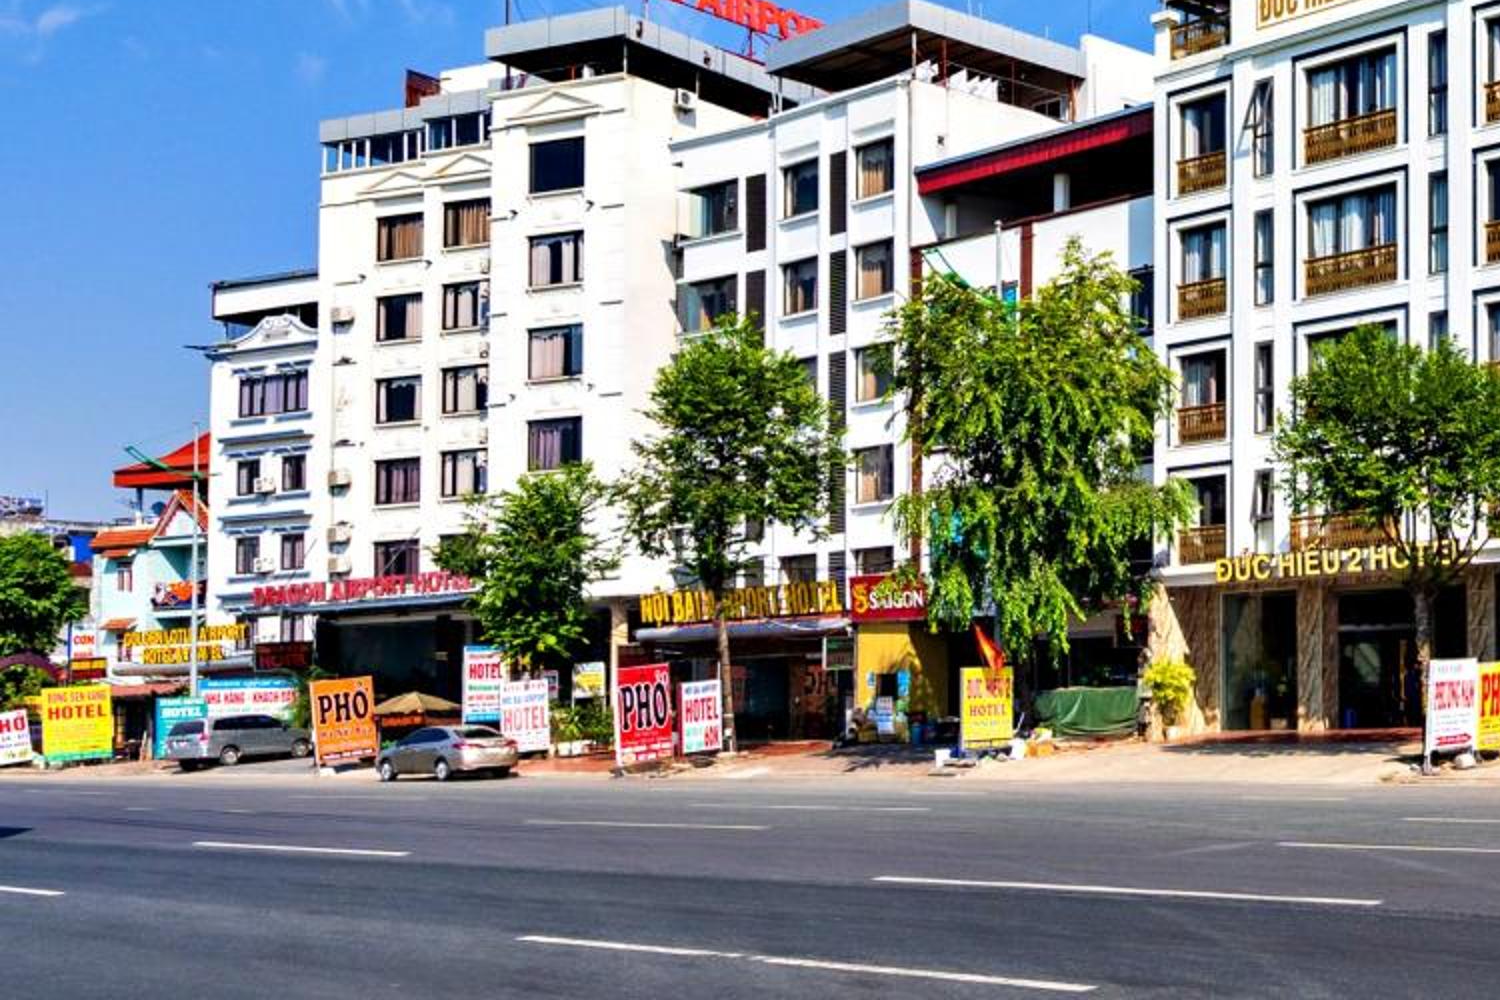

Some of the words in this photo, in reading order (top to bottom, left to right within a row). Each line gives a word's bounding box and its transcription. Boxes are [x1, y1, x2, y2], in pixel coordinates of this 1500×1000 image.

[1215, 546, 1271, 583] ĐỨC
[1278, 537, 1341, 578] HIẾU
[1347, 546, 1365, 573] 2
[331, 574, 406, 601] AIRPORT
[780, 580, 844, 616] HOTEL
[469, 662, 503, 680] HOTEL
[47, 703, 107, 720] HOTEL
[318, 681, 369, 724] PHỞ
[619, 668, 668, 732] PHỞ
[684, 696, 719, 723] HOTEL
[969, 703, 1007, 717] HOTEL
[503, 704, 549, 732] HOTEL
